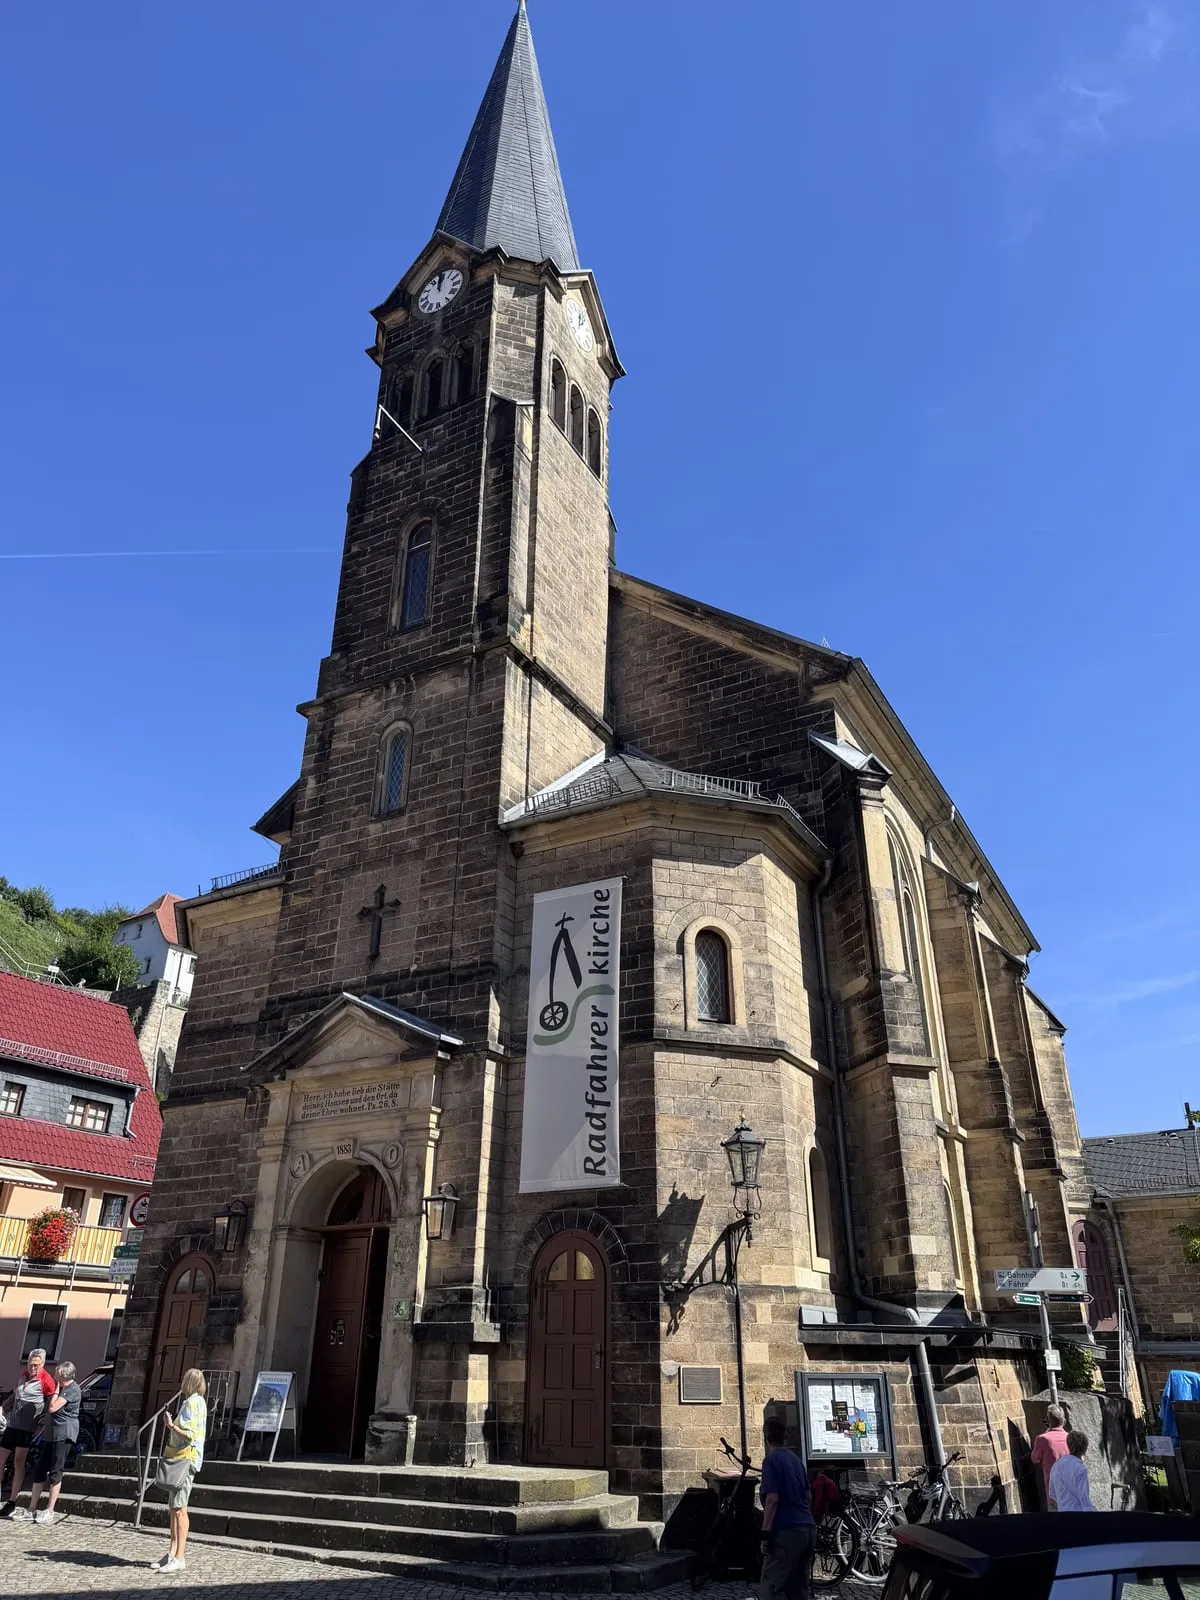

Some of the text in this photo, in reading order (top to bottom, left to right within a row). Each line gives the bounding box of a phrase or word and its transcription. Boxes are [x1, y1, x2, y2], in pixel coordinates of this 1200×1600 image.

[583, 888, 610, 1176] Radfahrer kirche
[323, 1091, 333, 1100] ich
[334, 1089, 351, 1098] habe
[351, 1087, 364, 1097] lieb
[365, 1085, 377, 1094] die
[377, 1082, 401, 1092] Stätte
[302, 1101, 324, 1111] deines
[324, 1098, 349, 1107] Hauses
[350, 1096, 362, 1104] und
[362, 1094, 375, 1103] den
[389, 1089, 398, 1099] da
[301, 1109, 321, 1120] deine
[321, 1107, 338, 1117] Ehre
[336, 1143, 352, 1155] 1883
[1007, 1271, 1037, 1279] Bahnhof
[1008, 1280, 1029, 1288] Fähre
